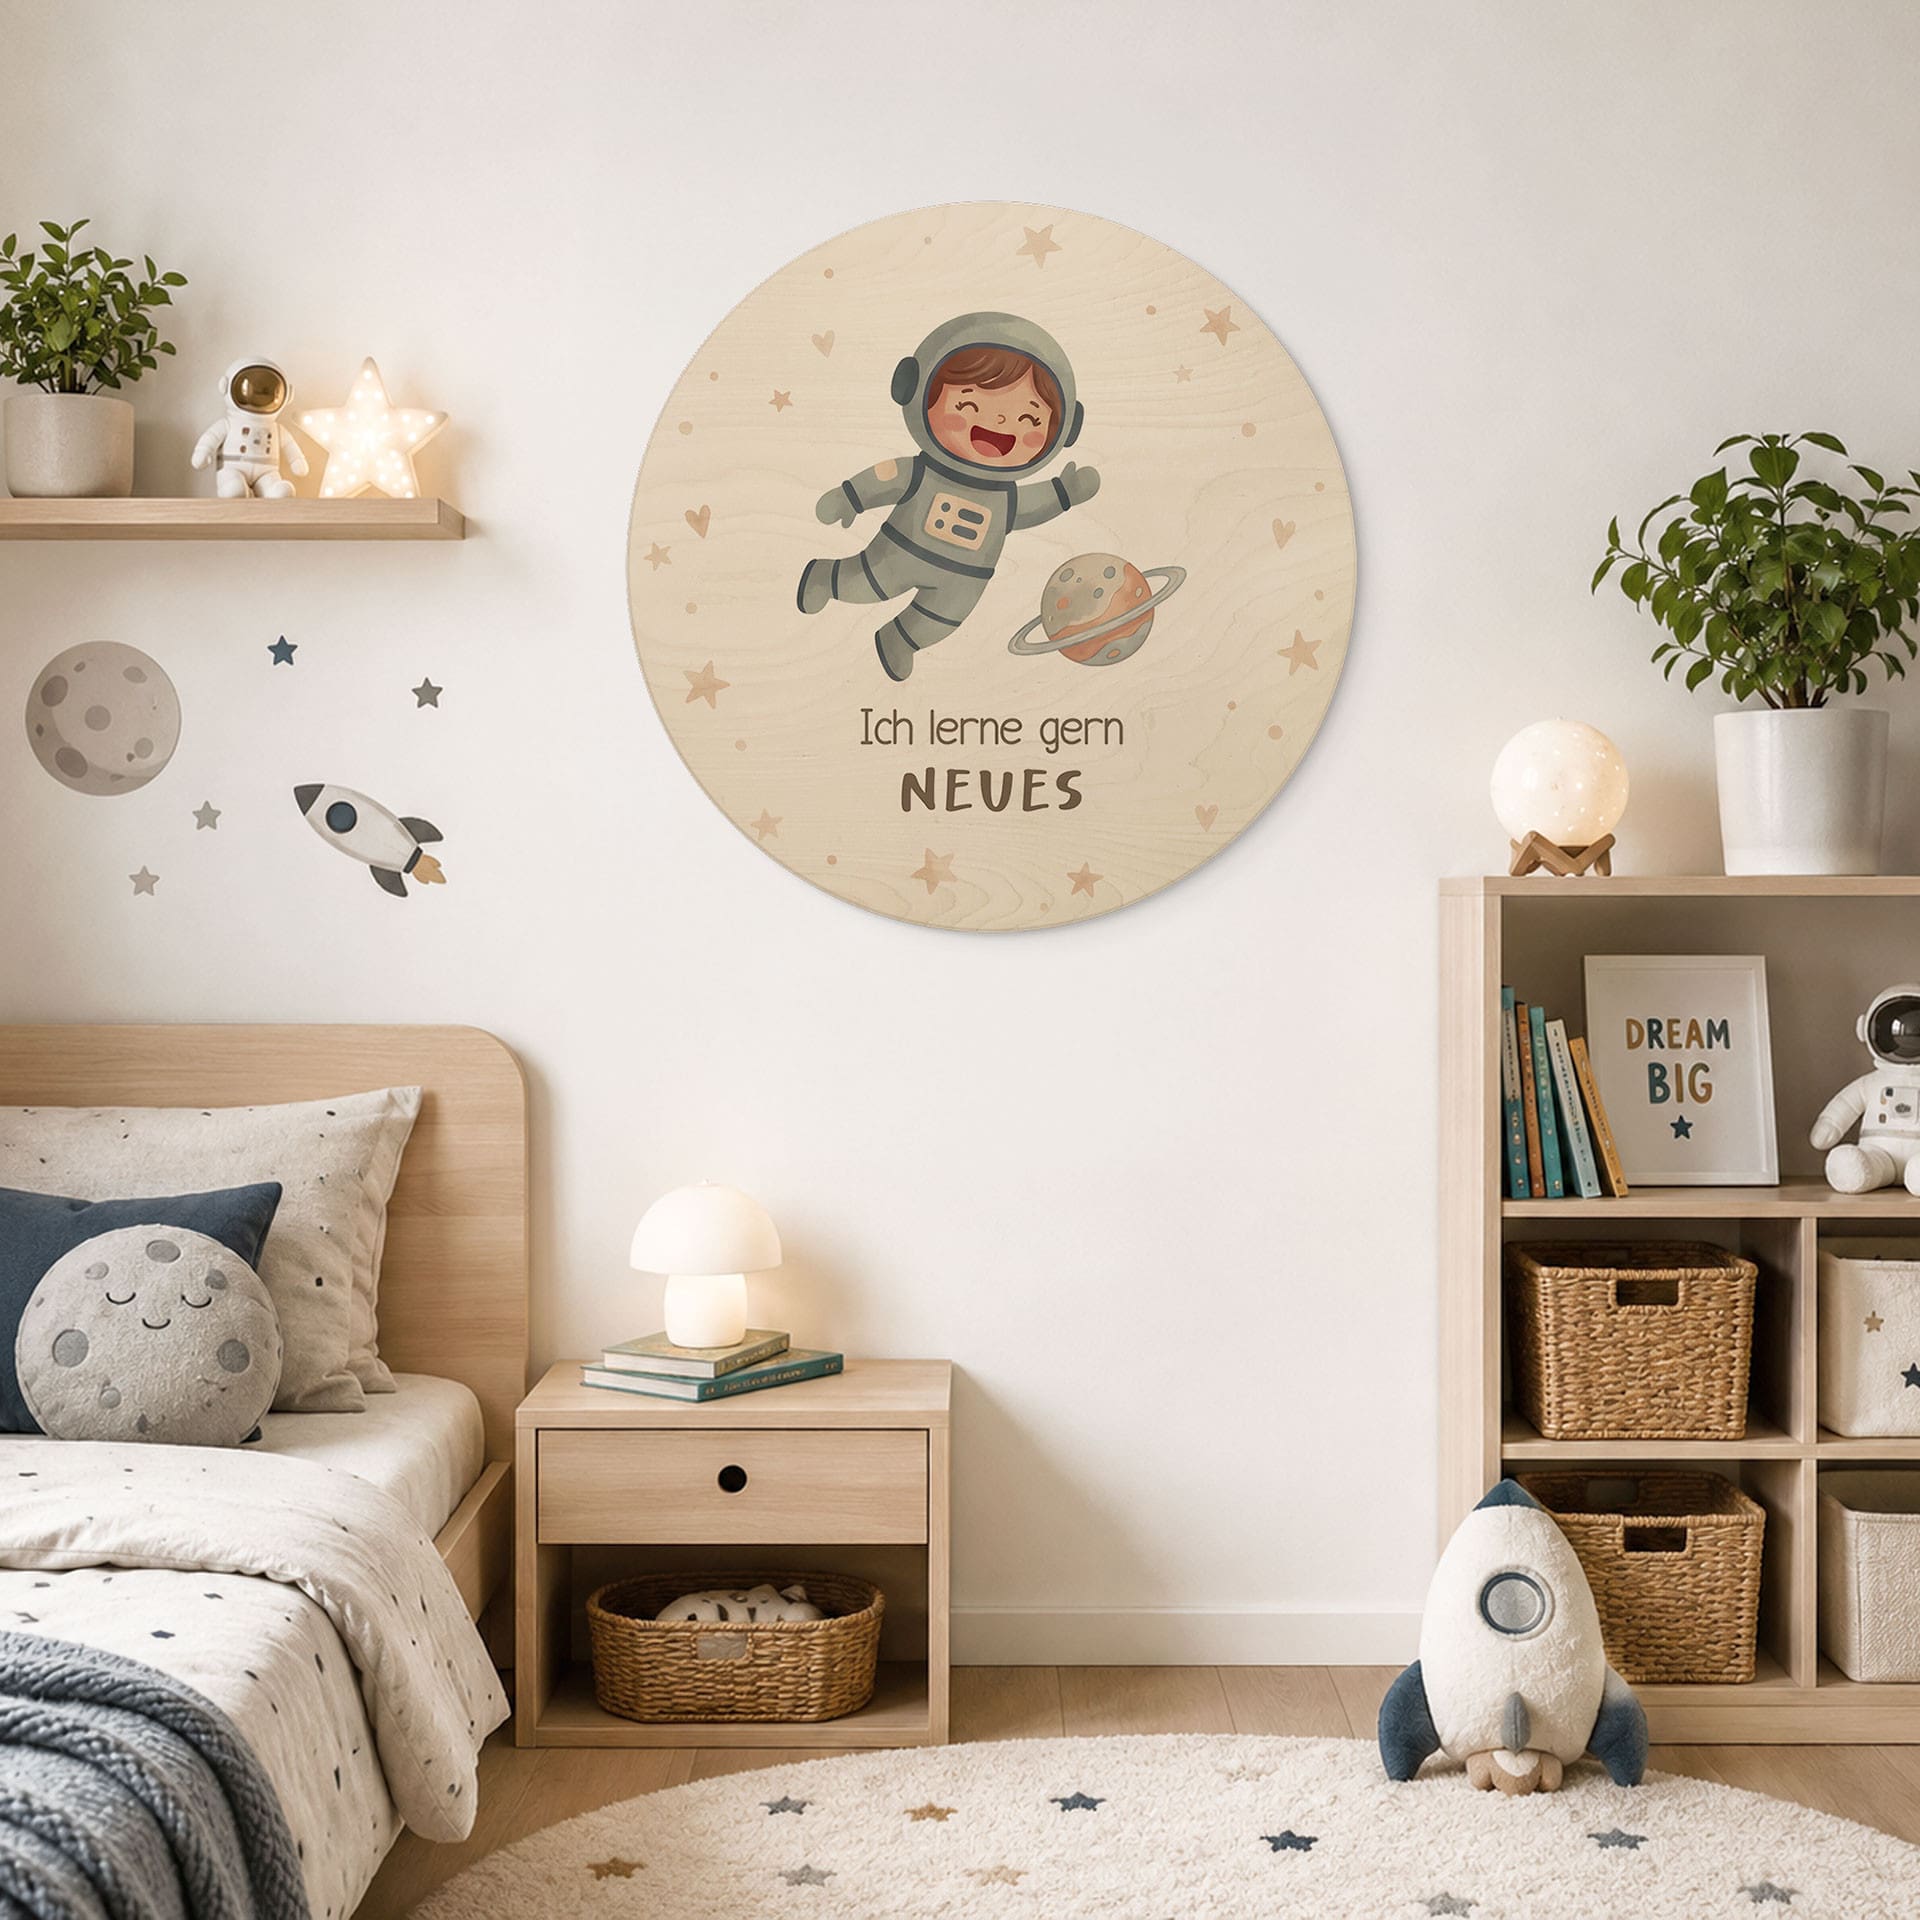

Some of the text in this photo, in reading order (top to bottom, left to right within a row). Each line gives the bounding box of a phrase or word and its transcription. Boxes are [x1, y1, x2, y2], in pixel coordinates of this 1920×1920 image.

[860, 708, 1124, 754] Ich lerne gern
[901, 767, 1082, 812] NEUES
[1625, 1018, 1730, 1050] DREAM
[1648, 1062, 1713, 1104] BIG
